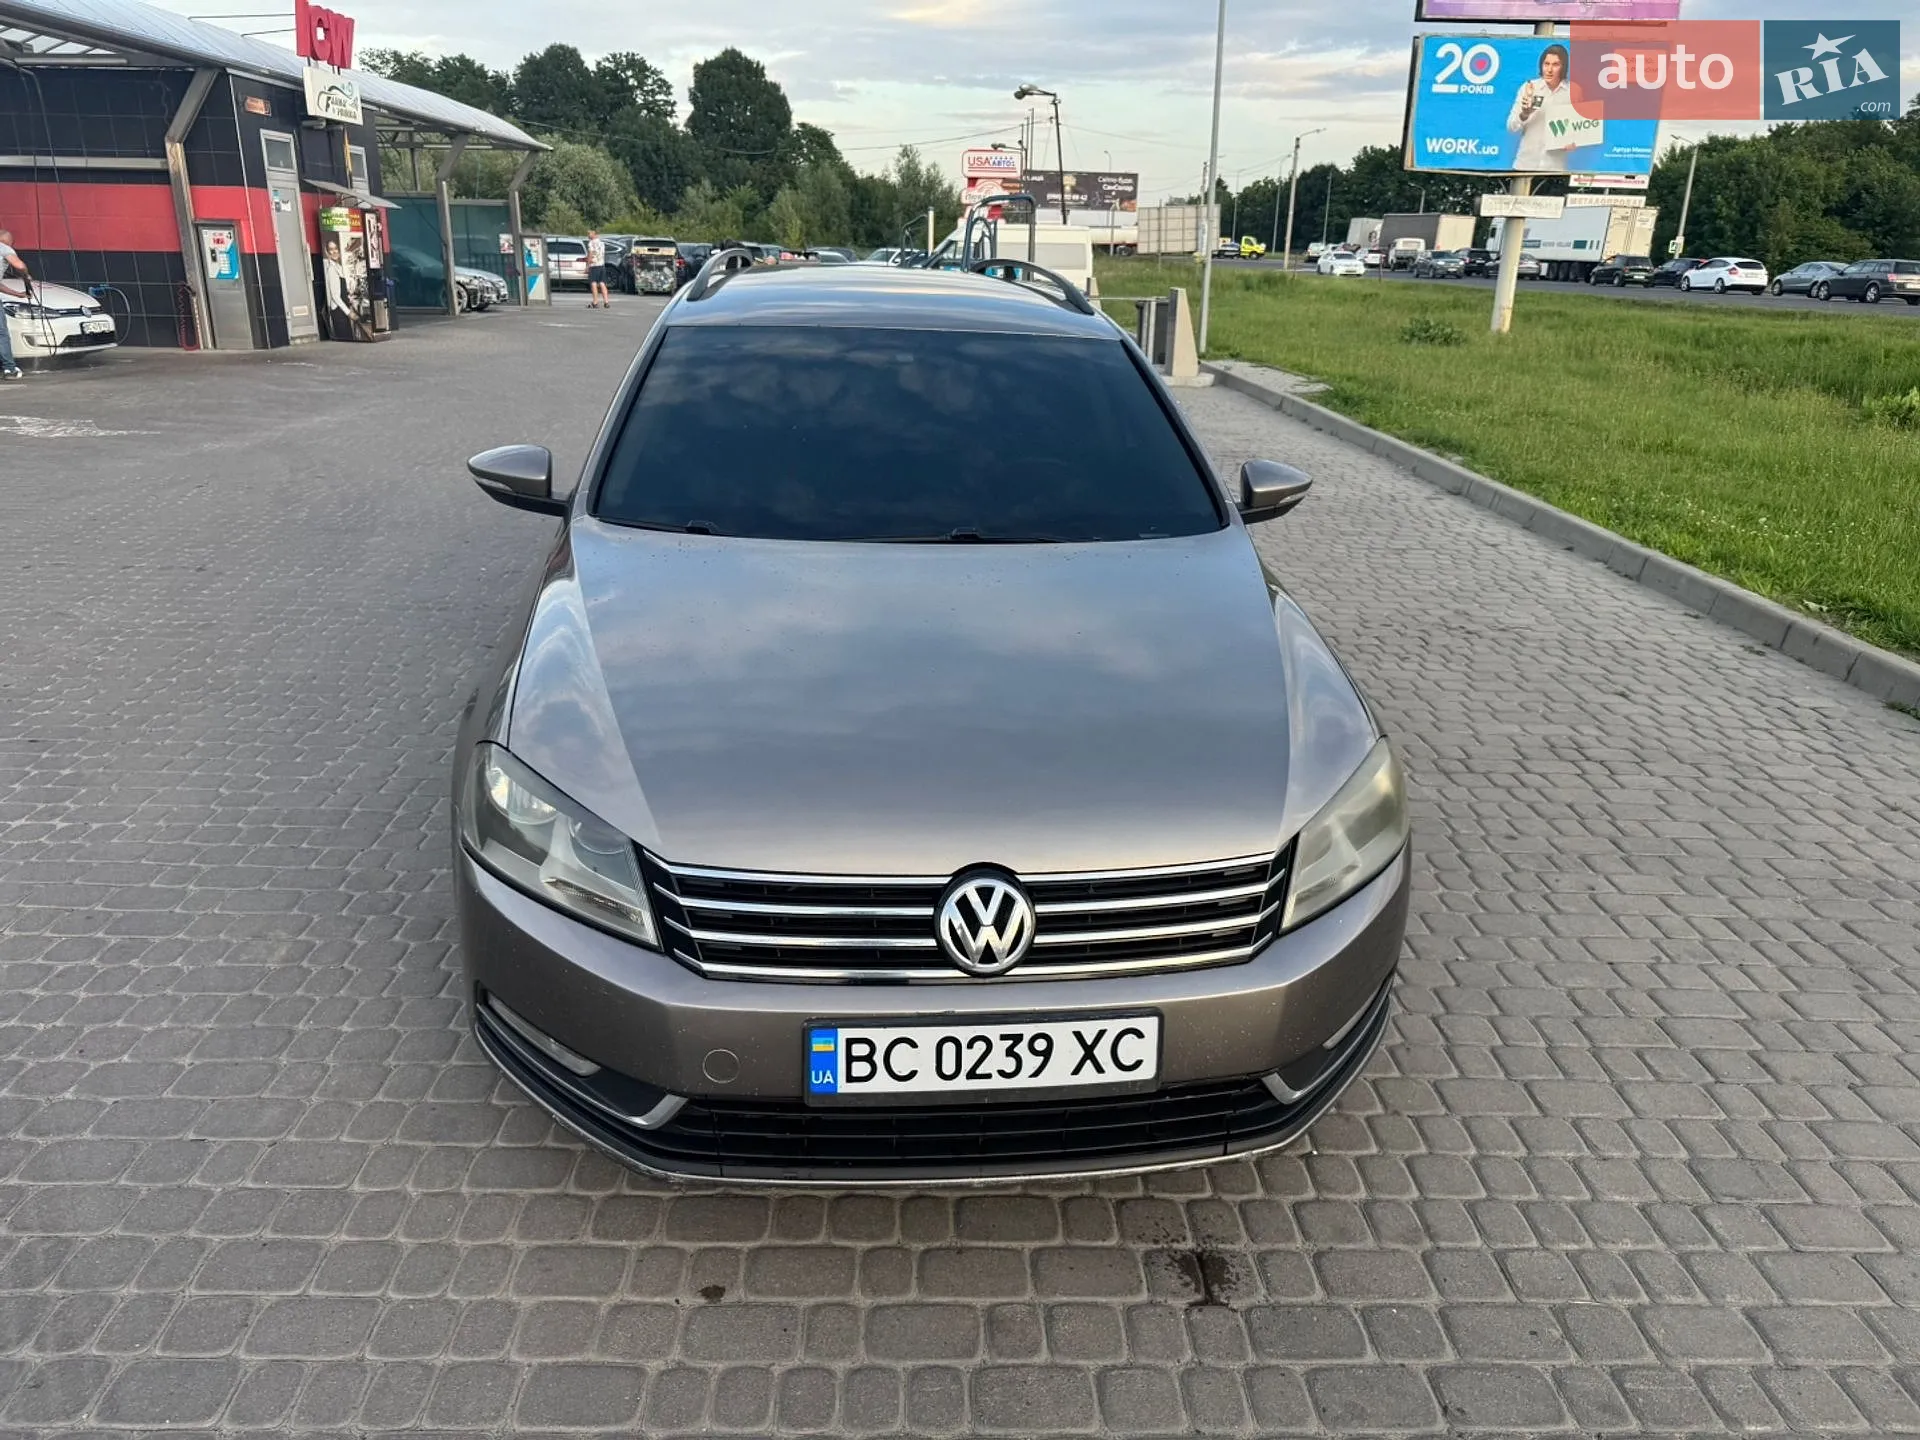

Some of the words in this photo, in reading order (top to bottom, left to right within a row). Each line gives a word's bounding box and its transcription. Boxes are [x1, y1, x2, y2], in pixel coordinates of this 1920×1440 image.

[1435, 42, 1500, 84] 20
[1460, 84, 1494, 94] РОКІВ
[1571, 119, 1600, 131] WOG
[1425, 137, 1499, 155] WORK.ua
[967, 155, 991, 167] USA
[845, 1037, 919, 1084] BC
[935, 1032, 1055, 1081] 0239
[1070, 1027, 1146, 1076] XC
[811, 1070, 834, 1085] UA
